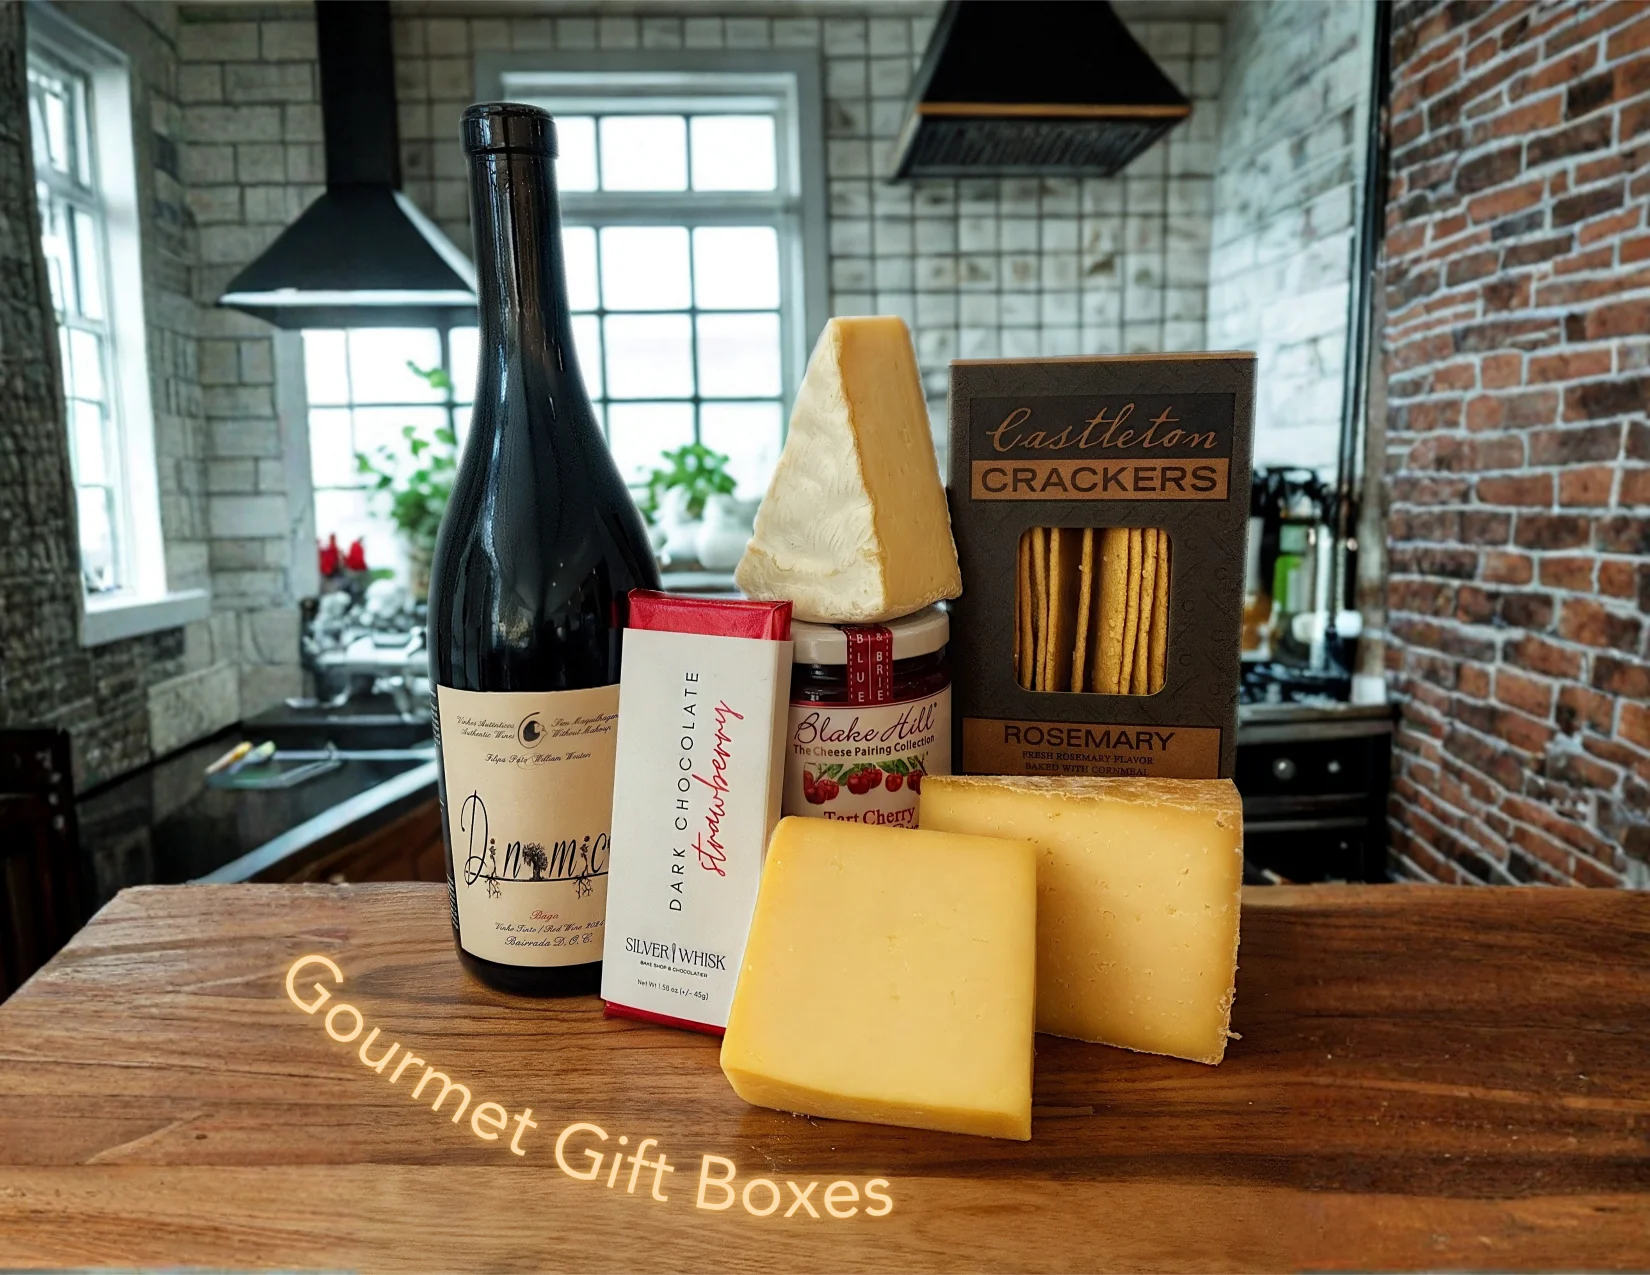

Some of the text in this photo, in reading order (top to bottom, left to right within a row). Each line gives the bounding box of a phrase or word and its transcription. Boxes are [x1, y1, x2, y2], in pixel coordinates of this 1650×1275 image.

[986, 403, 1217, 452] Castleton
[981, 466, 1217, 492] CRACKERS
[875, 633, 883, 641] &
[856, 633, 865, 702] BLUE
[794, 703, 935, 744] Blake Hill
[793, 734, 935, 757] The Cheese Pairing Collection
[1004, 725, 1175, 751] ROSEMARY
[1022, 751, 1153, 765] FRESH ROSEMARY FLAVOR
[1025, 763, 1149, 777] BAKED WITH CORNMEAL
[669, 672, 699, 911] DARK CHOCOLATE
[691, 700, 744, 877] strawberry
[863, 806, 915, 826] Cherry
[543, 924, 563, 933] Red
[564, 922, 583, 932] Wine
[504, 935, 552, 947] Bairrada
[625, 937, 726, 971] SILVER WHISK
[640, 960, 653, 968] BAKE
[672, 967, 708, 978] CHOCOLATIER
[637, 979, 648, 987] Net
[649, 981, 657, 989] Wt
